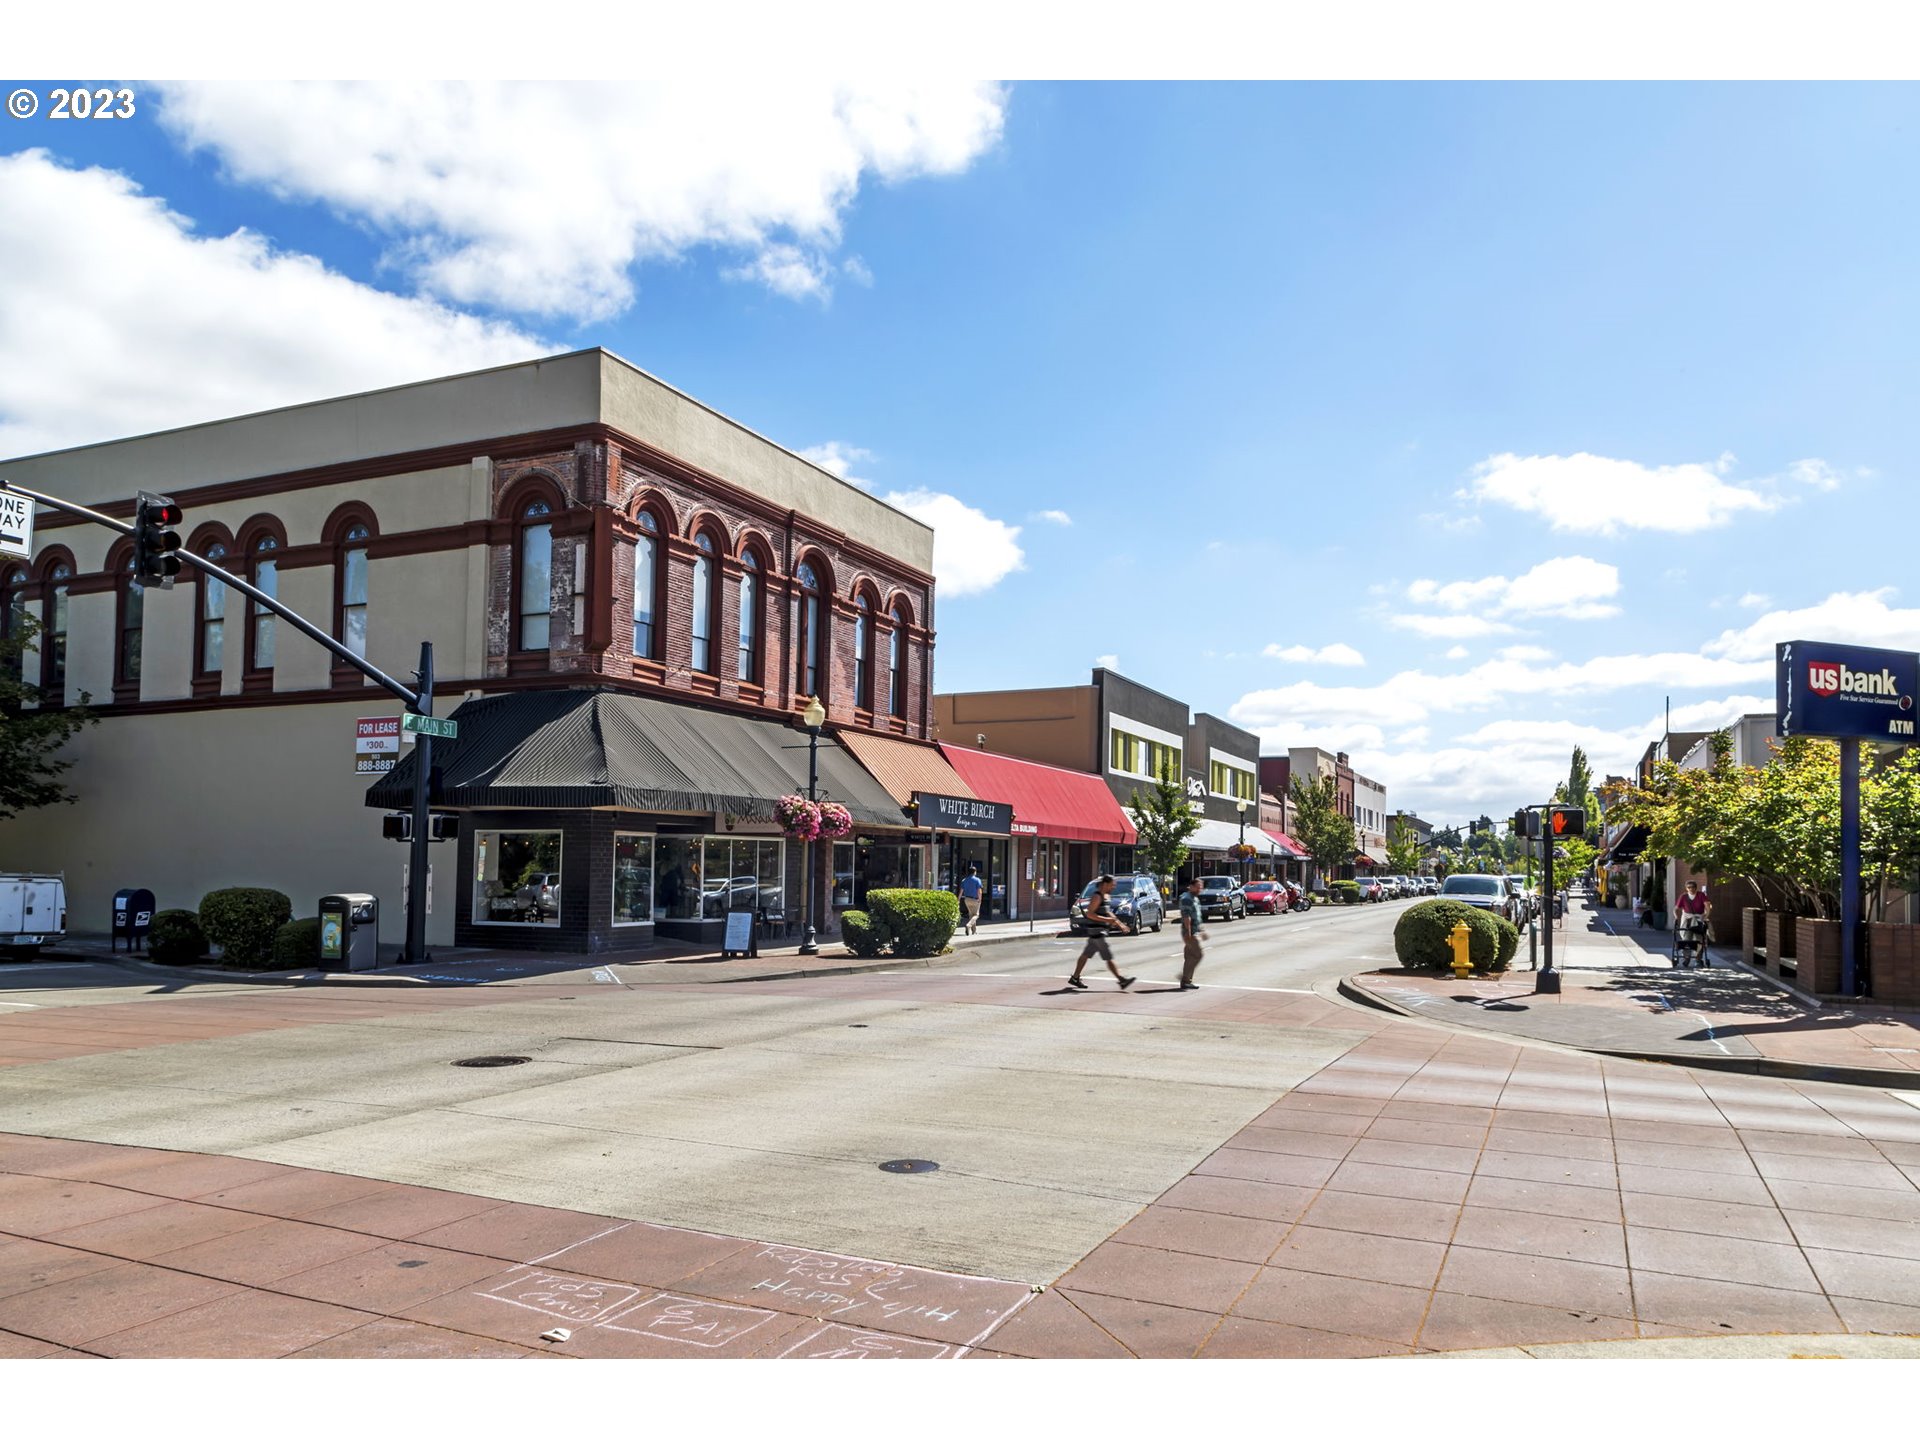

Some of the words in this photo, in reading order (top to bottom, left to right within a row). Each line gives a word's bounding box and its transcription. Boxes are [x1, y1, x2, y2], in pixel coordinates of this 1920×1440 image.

[0, 512, 25, 530] AY
[359, 723, 374, 734] FOR
[375, 722, 398, 734] LEASE
[407, 716, 413, 729] E
[417, 718, 439, 734] MAIN
[442, 722, 454, 735] ST
[1888, 720, 1914, 735] ATM
[357, 760, 396, 771] 888-8887
[939, 799, 969, 816] WHITE
[970, 803, 995, 819] BIRCH
